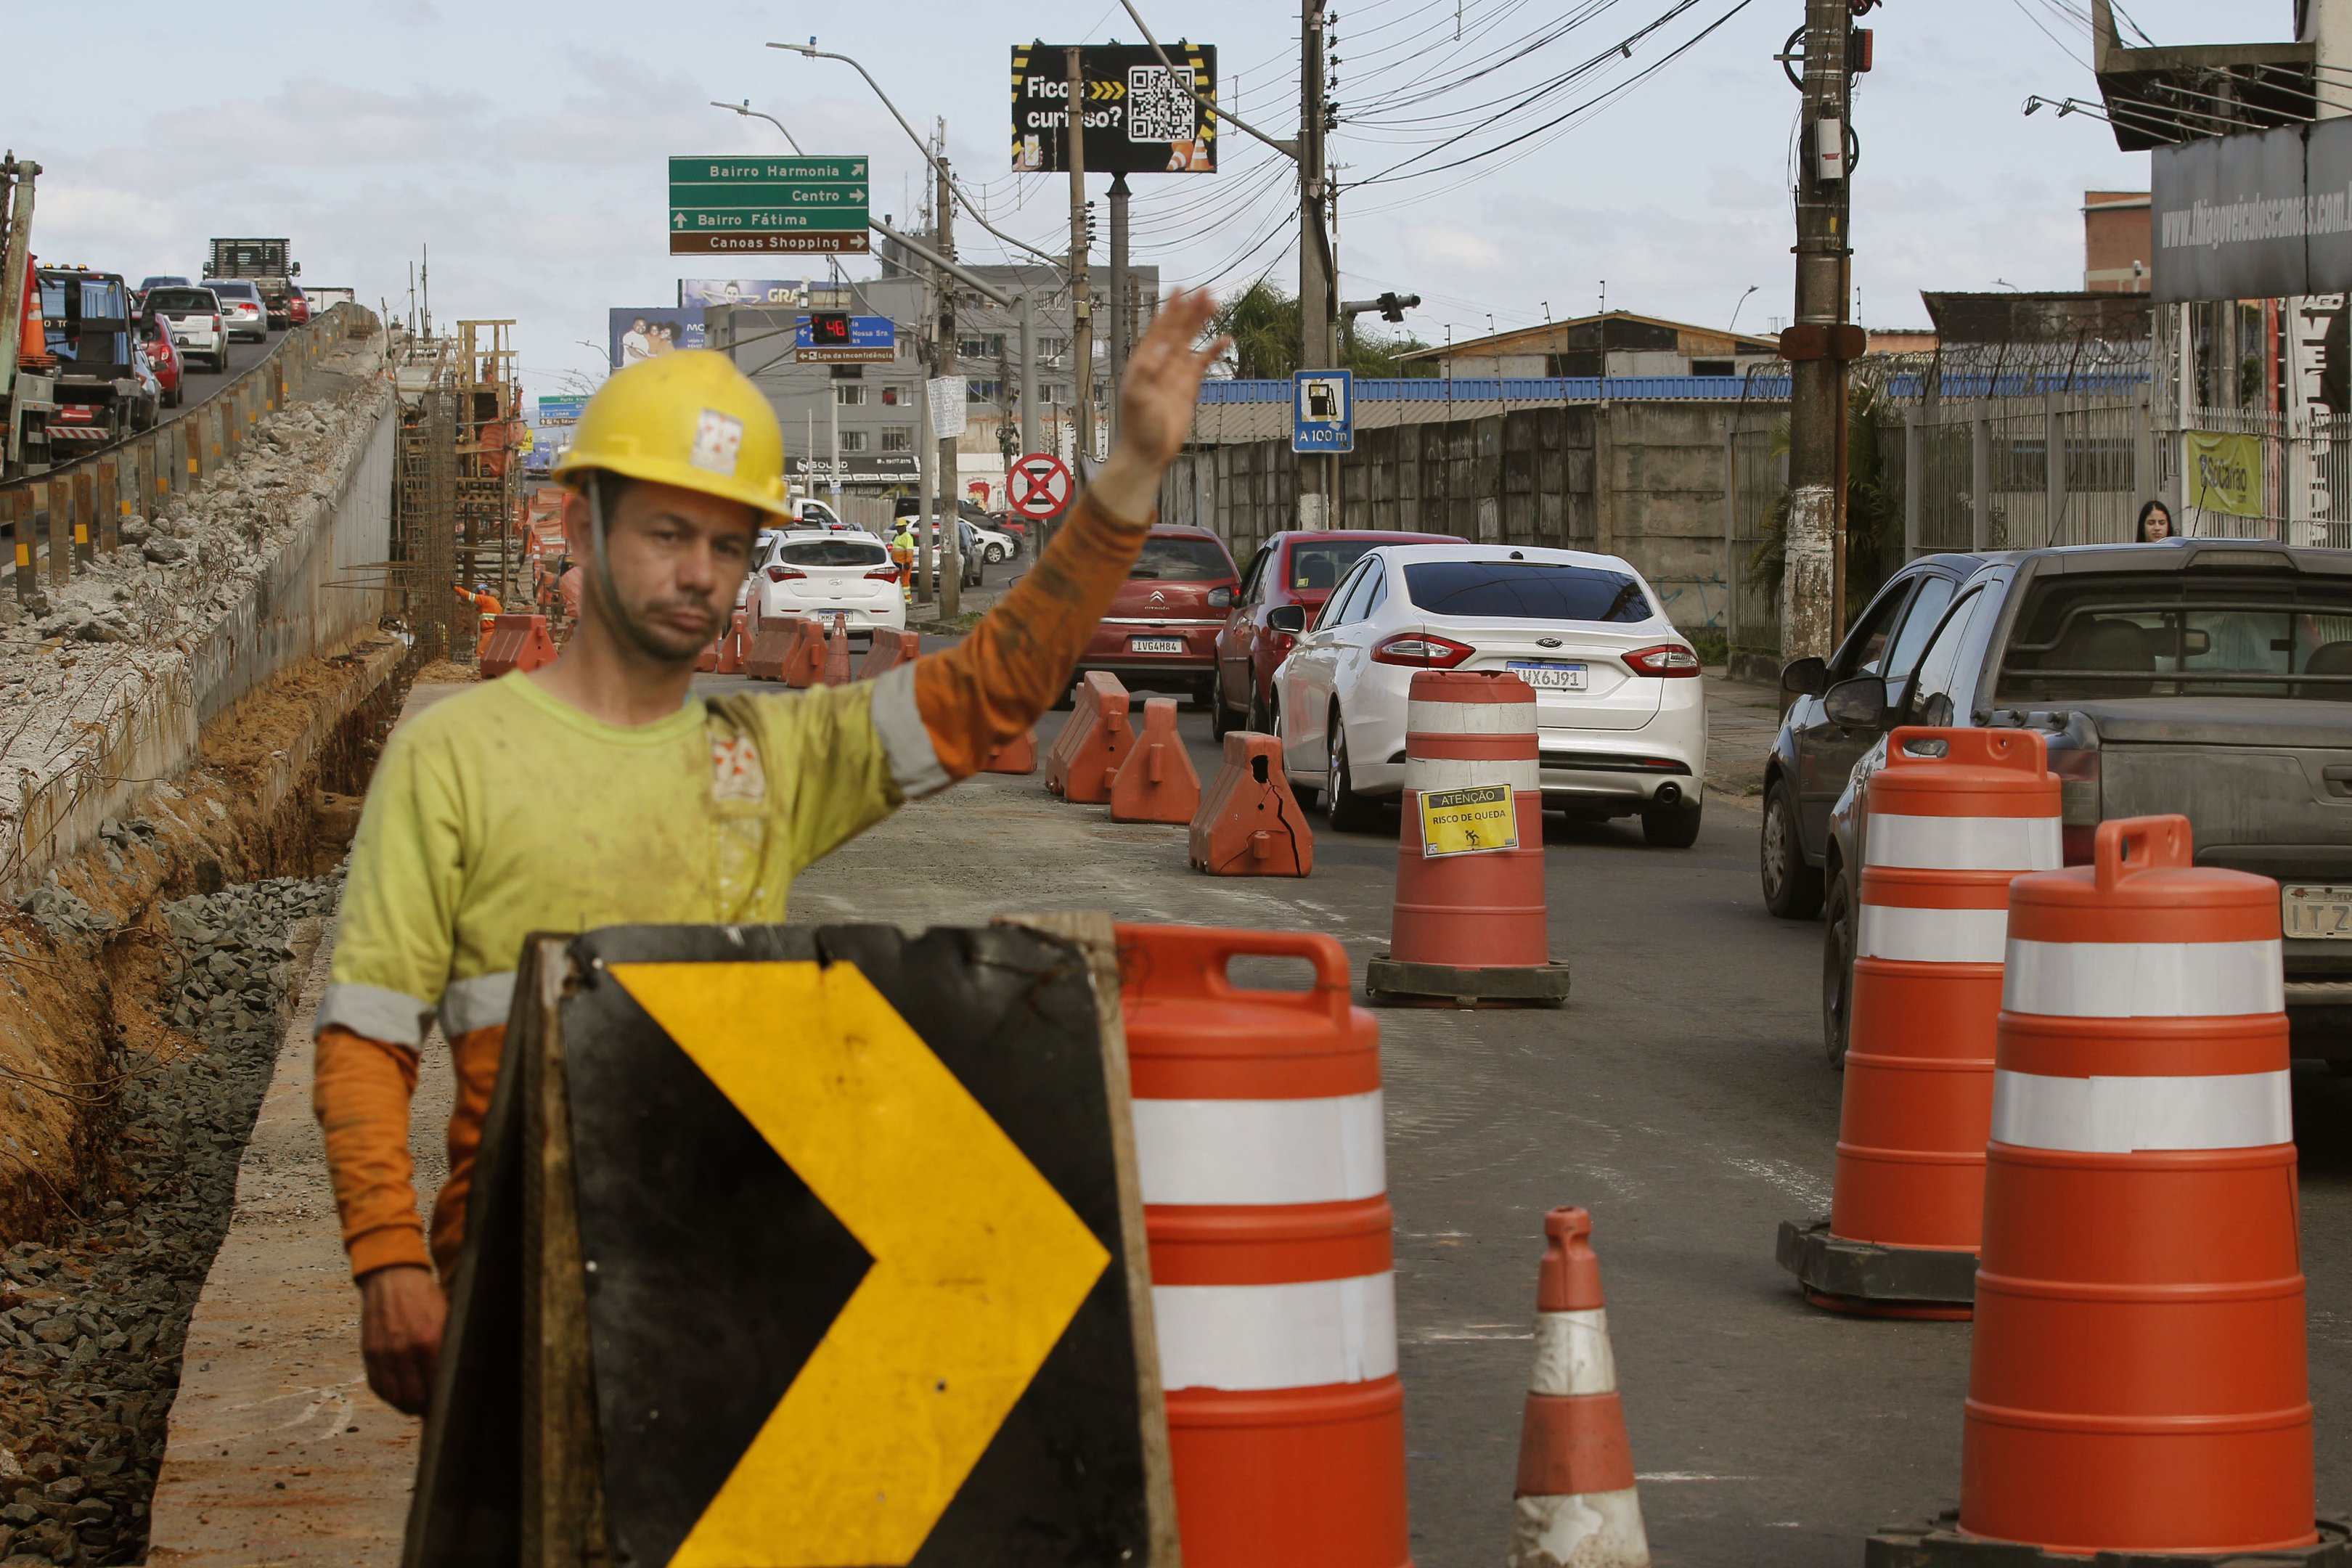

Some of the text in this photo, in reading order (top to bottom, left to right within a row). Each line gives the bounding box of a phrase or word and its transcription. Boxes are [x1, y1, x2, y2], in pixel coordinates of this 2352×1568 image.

[1027, 75, 1084, 98] Fico
[1027, 105, 1122, 128] curiso?
[710, 165, 840, 177] Bairro Harmonia
[792, 190, 840, 202] Centro
[698, 212, 807, 226] Bairro Fátima
[710, 237, 840, 250] Canoas Shopping
[825, 320, 846, 337] 48
[1299, 430, 1347, 441] A 100 m
[1137, 642, 1177, 651] IVG4H84
[1441, 790, 1495, 806] ATENÇÃO
[1432, 814, 1459, 825] RISCO
[1474, 809, 1506, 821] QUEDA
